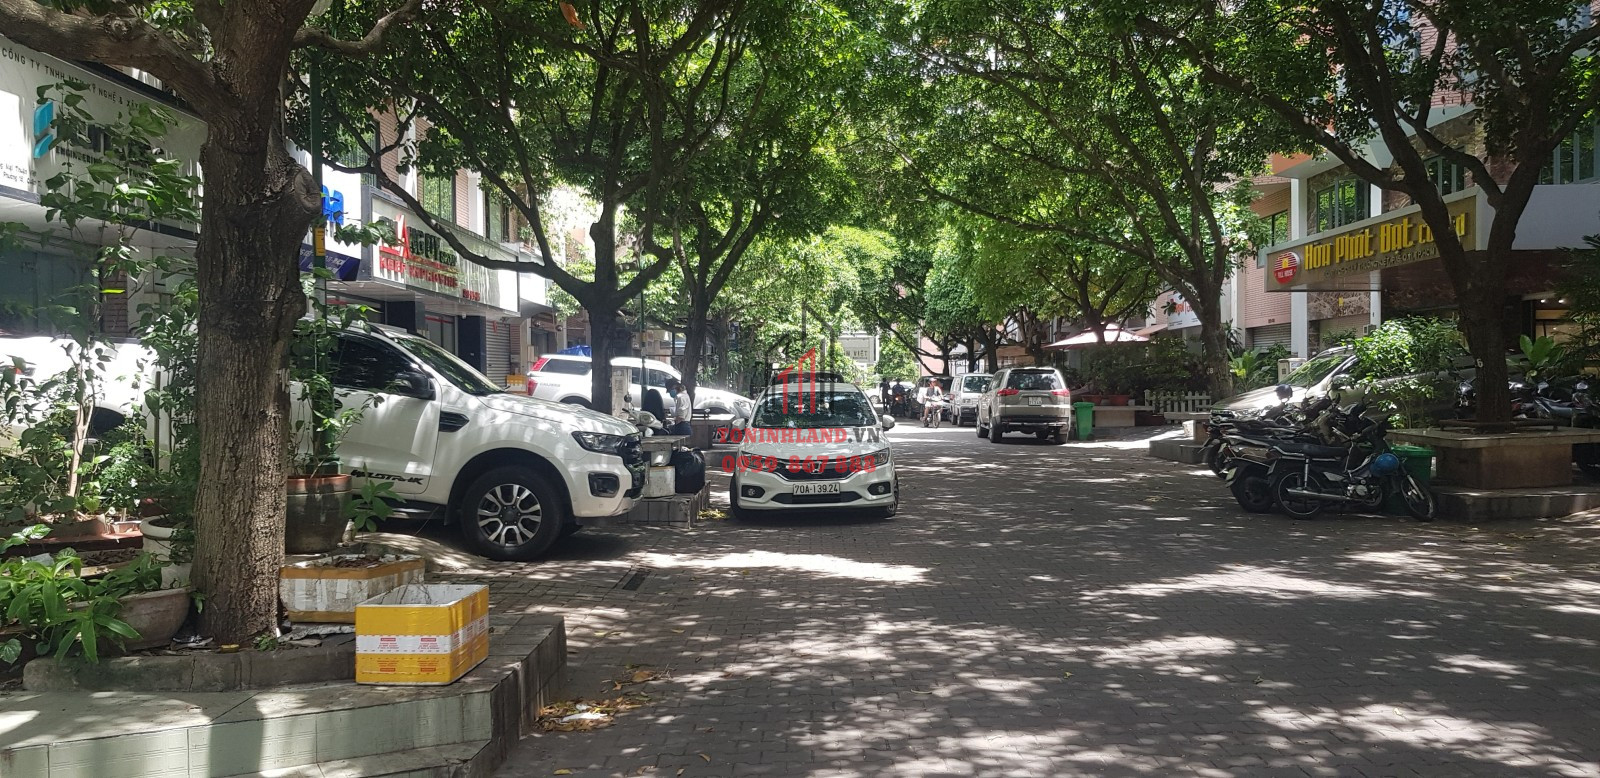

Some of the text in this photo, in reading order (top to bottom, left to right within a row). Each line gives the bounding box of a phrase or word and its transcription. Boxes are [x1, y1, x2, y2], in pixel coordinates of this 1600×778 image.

[1, 47, 26, 65] CÔNG
[30, 59, 40, 71] TY
[44, 65, 65, 80] TNHH
[98, 88, 117, 104] NGHỆ
[794, 483, 839, 495] 70A-139.24
